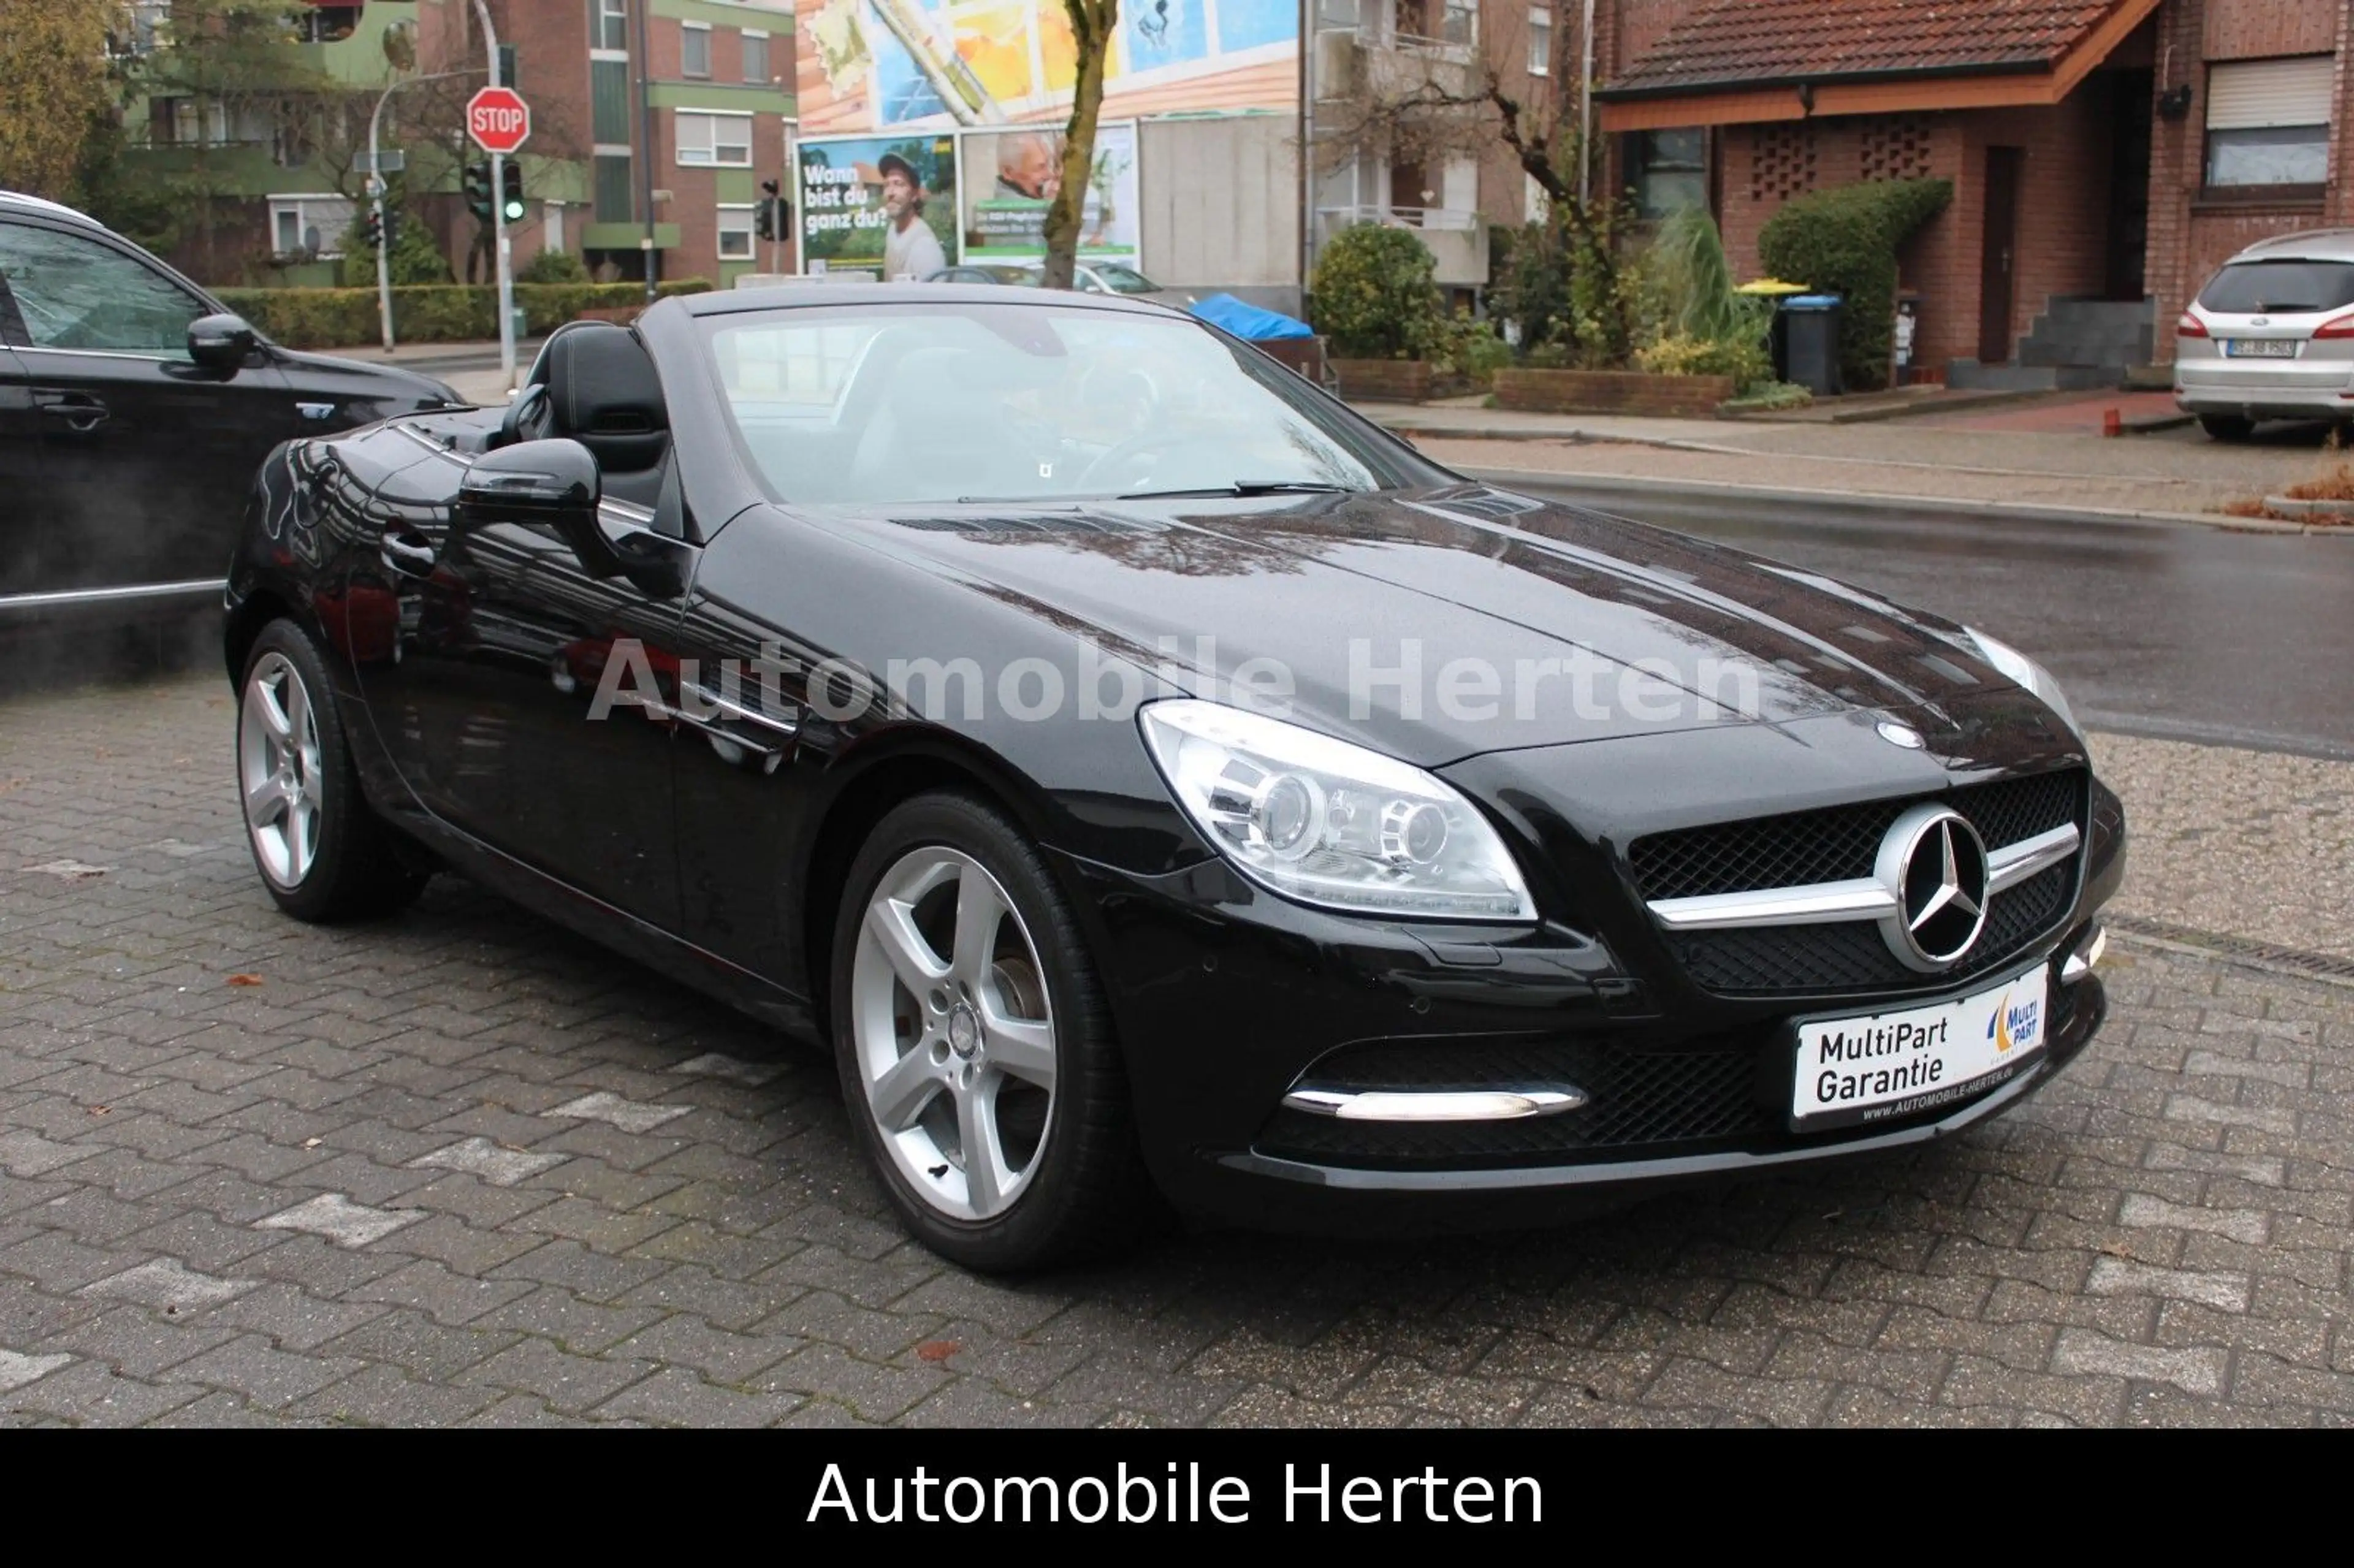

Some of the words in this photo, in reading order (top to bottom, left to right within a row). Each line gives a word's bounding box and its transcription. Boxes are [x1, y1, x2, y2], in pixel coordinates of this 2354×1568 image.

[474, 107, 523, 132] STOP
[804, 164, 858, 185] Wann
[804, 186, 841, 208] bist
[844, 185, 869, 205] du
[806, 213, 852, 235] ganz
[854, 207, 888, 229] du?
[2006, 999, 2037, 1031] MULTI
[1819, 1017, 1948, 1064] MultiPart
[2014, 1018, 2037, 1045] PART
[1816, 1054, 1943, 1103] Garantie
